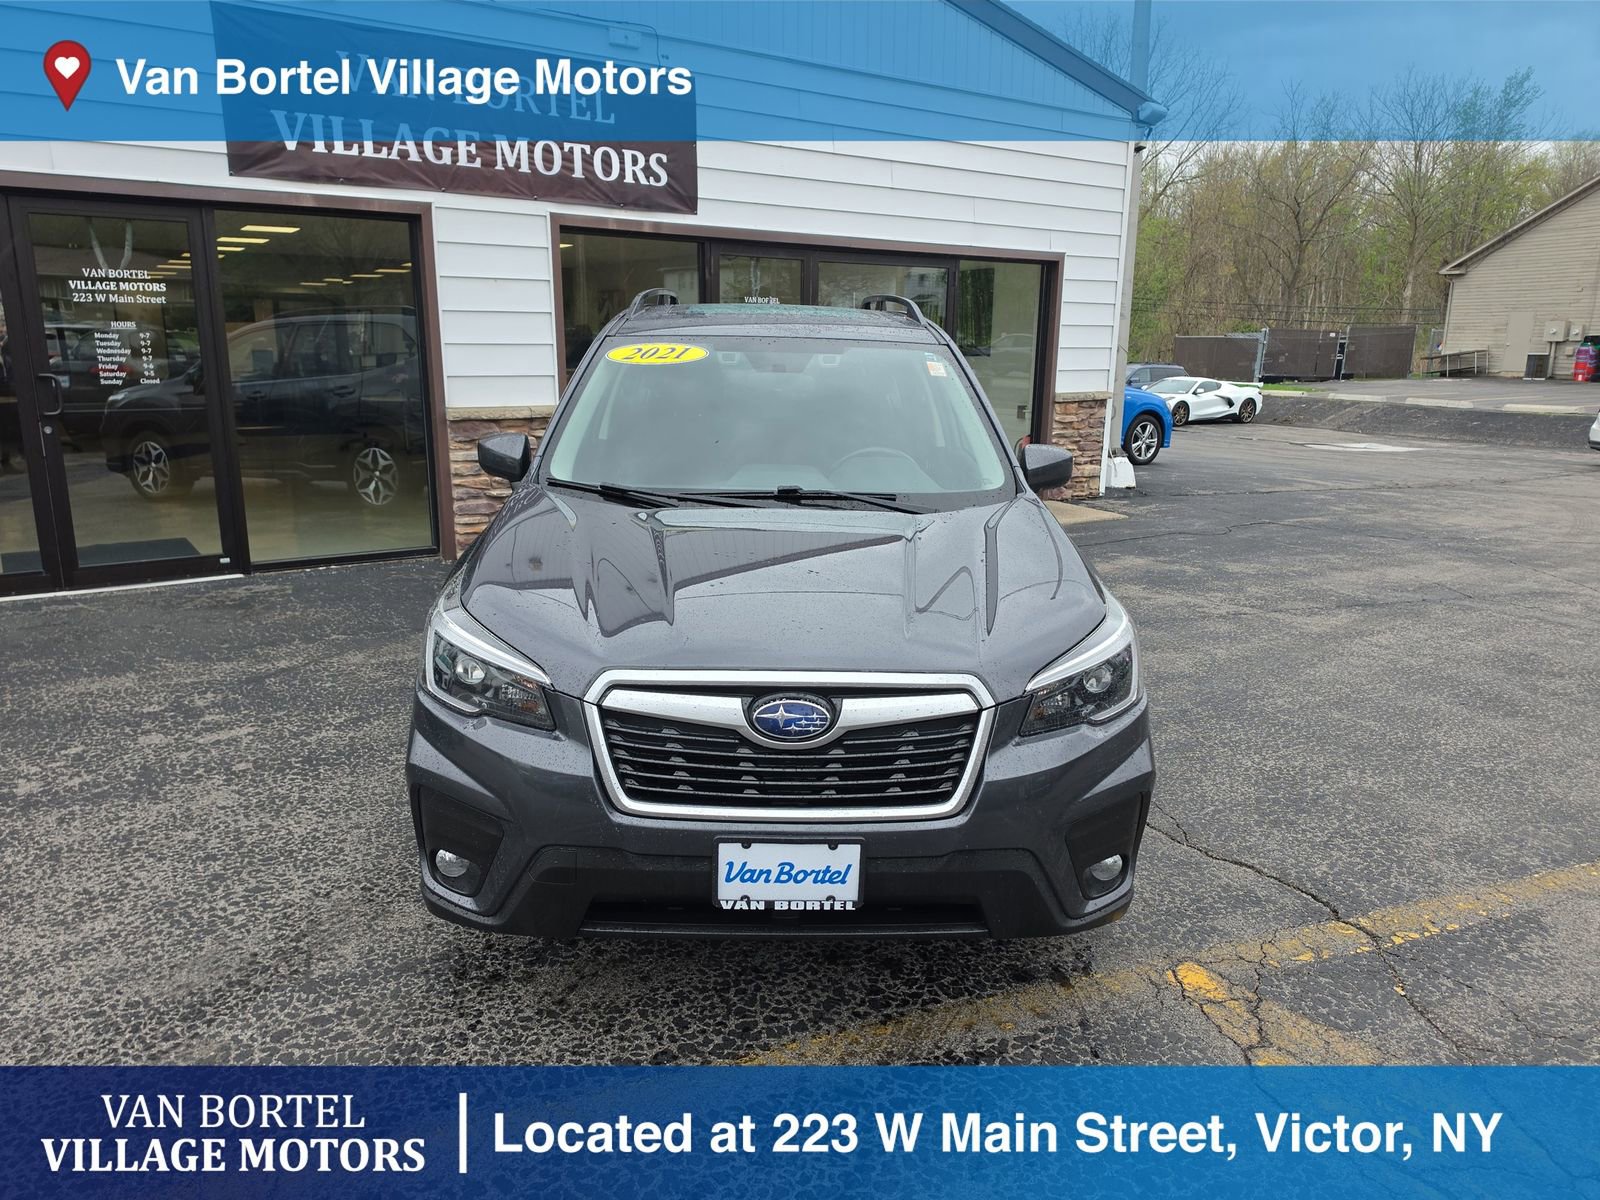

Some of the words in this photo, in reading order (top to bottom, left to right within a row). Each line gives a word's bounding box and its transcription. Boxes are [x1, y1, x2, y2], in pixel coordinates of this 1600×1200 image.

[270, 109, 482, 168] VILLAGE
[494, 133, 668, 187] MOTORS
[82, 268, 105, 278] VAN
[108, 269, 151, 279] BORTEL
[68, 280, 118, 291] VILLAGE
[119, 282, 167, 292] MOTORS
[72, 293, 93, 303] 223
[95, 293, 107, 303] W
[109, 294, 134, 304] Main
[136, 295, 167, 304] Street
[744, 296, 757, 304] VAN
[94, 332, 119, 340] Monday
[95, 340, 121, 348] Tuesday
[96, 348, 131, 356] Wednesday
[622, 347, 691, 360] 2021
[98, 363, 118, 371] Friday
[725, 861, 772, 883] Van
[774, 862, 852, 885] Bortel
[719, 899, 765, 911] VAN
[774, 900, 856, 911] BORTEL
